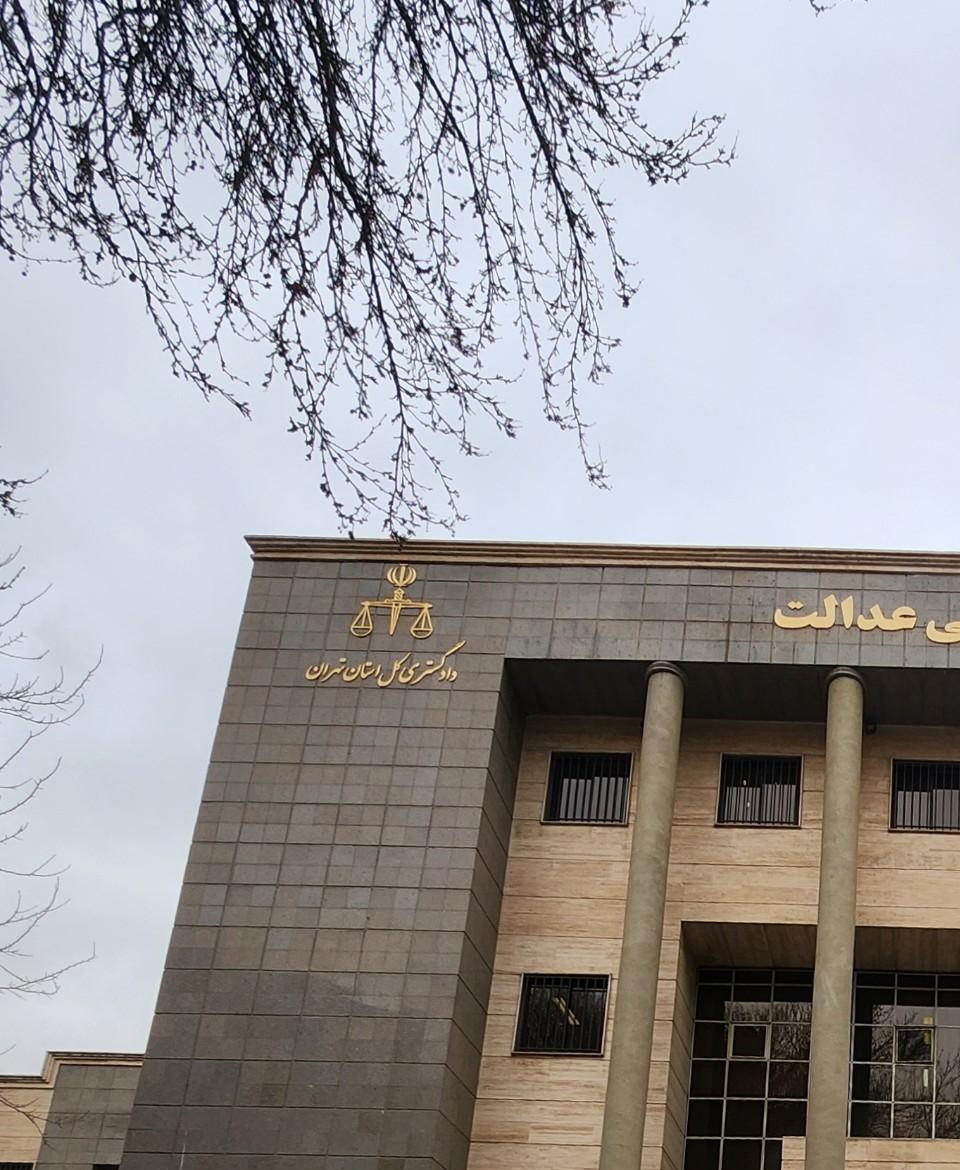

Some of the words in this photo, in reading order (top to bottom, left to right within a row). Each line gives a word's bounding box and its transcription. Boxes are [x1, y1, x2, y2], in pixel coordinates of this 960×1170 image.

[773, 594, 918, 631] عدالت
[305, 657, 347, 683] تهران
[343, 661, 382, 682] استان
[377, 652, 412, 687] کل
